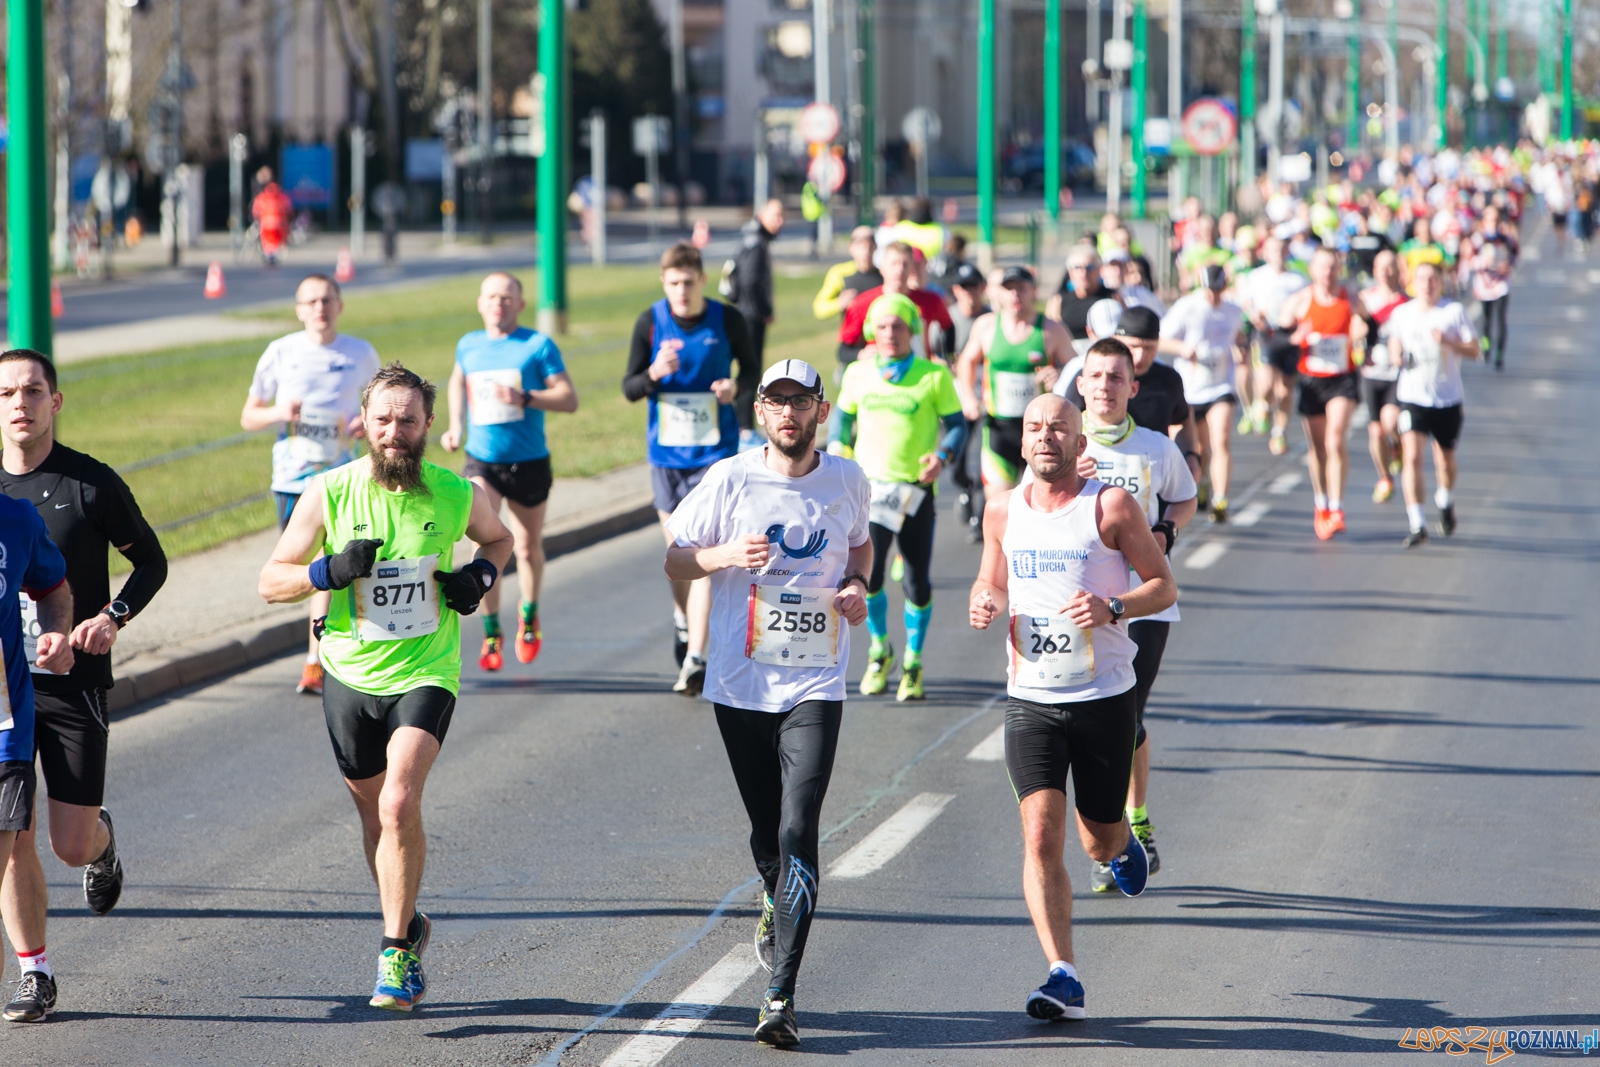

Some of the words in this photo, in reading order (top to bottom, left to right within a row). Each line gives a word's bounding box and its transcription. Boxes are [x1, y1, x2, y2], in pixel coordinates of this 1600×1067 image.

[1039, 549, 1088, 560] MUROWANA
[1039, 562, 1067, 572] DYCHA
[372, 580, 426, 607] 8771
[390, 607, 413, 615] Leszek
[767, 609, 827, 634] 2558
[1030, 633, 1072, 654] 262
